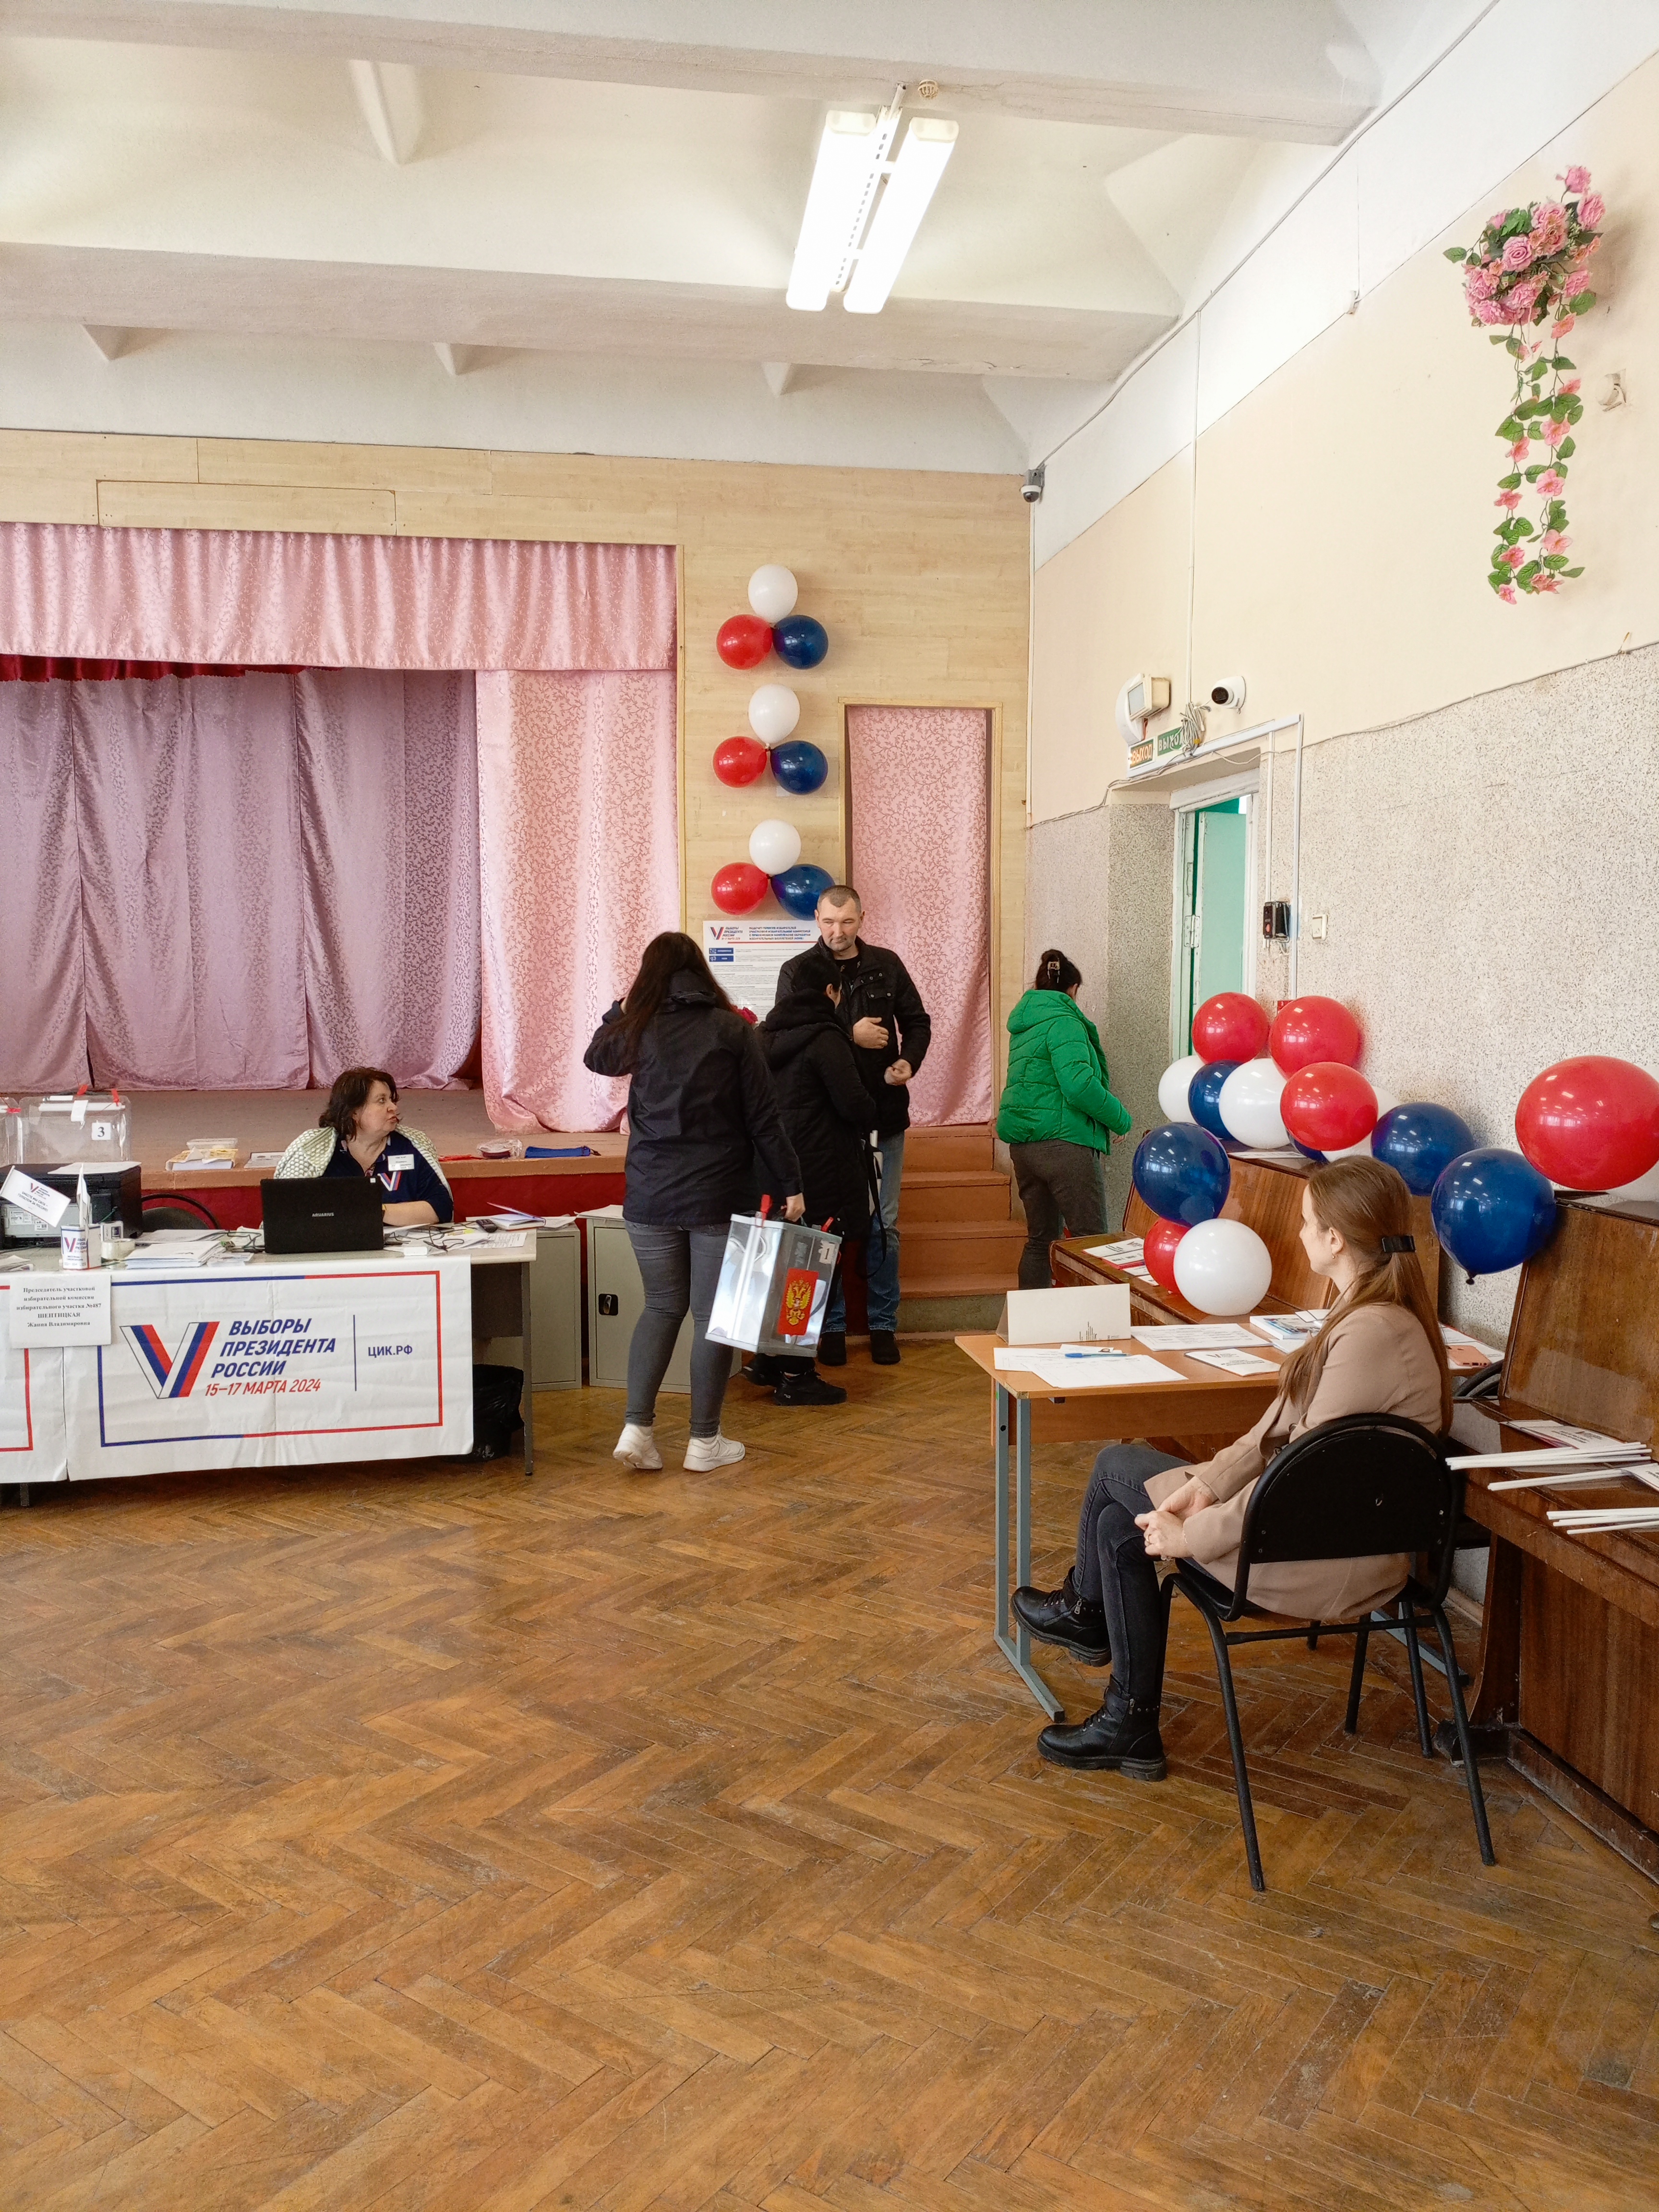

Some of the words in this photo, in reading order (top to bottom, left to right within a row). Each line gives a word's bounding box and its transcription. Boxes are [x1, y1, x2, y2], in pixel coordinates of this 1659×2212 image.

[1158, 732, 1182, 751] ВЫХО
[1132, 744, 1153, 763] ВЫХОД
[97, 1127, 105, 1137] 3
[824, 1248, 830, 1260] 1
[228, 1318, 312, 1336] ВЫБОРЫ
[219, 1338, 336, 1357] ПРЕЗИДЕНТА
[368, 1345, 413, 1358] ЦИК.РФ
[211, 1360, 287, 1378] РОССИИ
[244, 1380, 288, 1395] МАРТА
[289, 1378, 321, 1393] 2024
